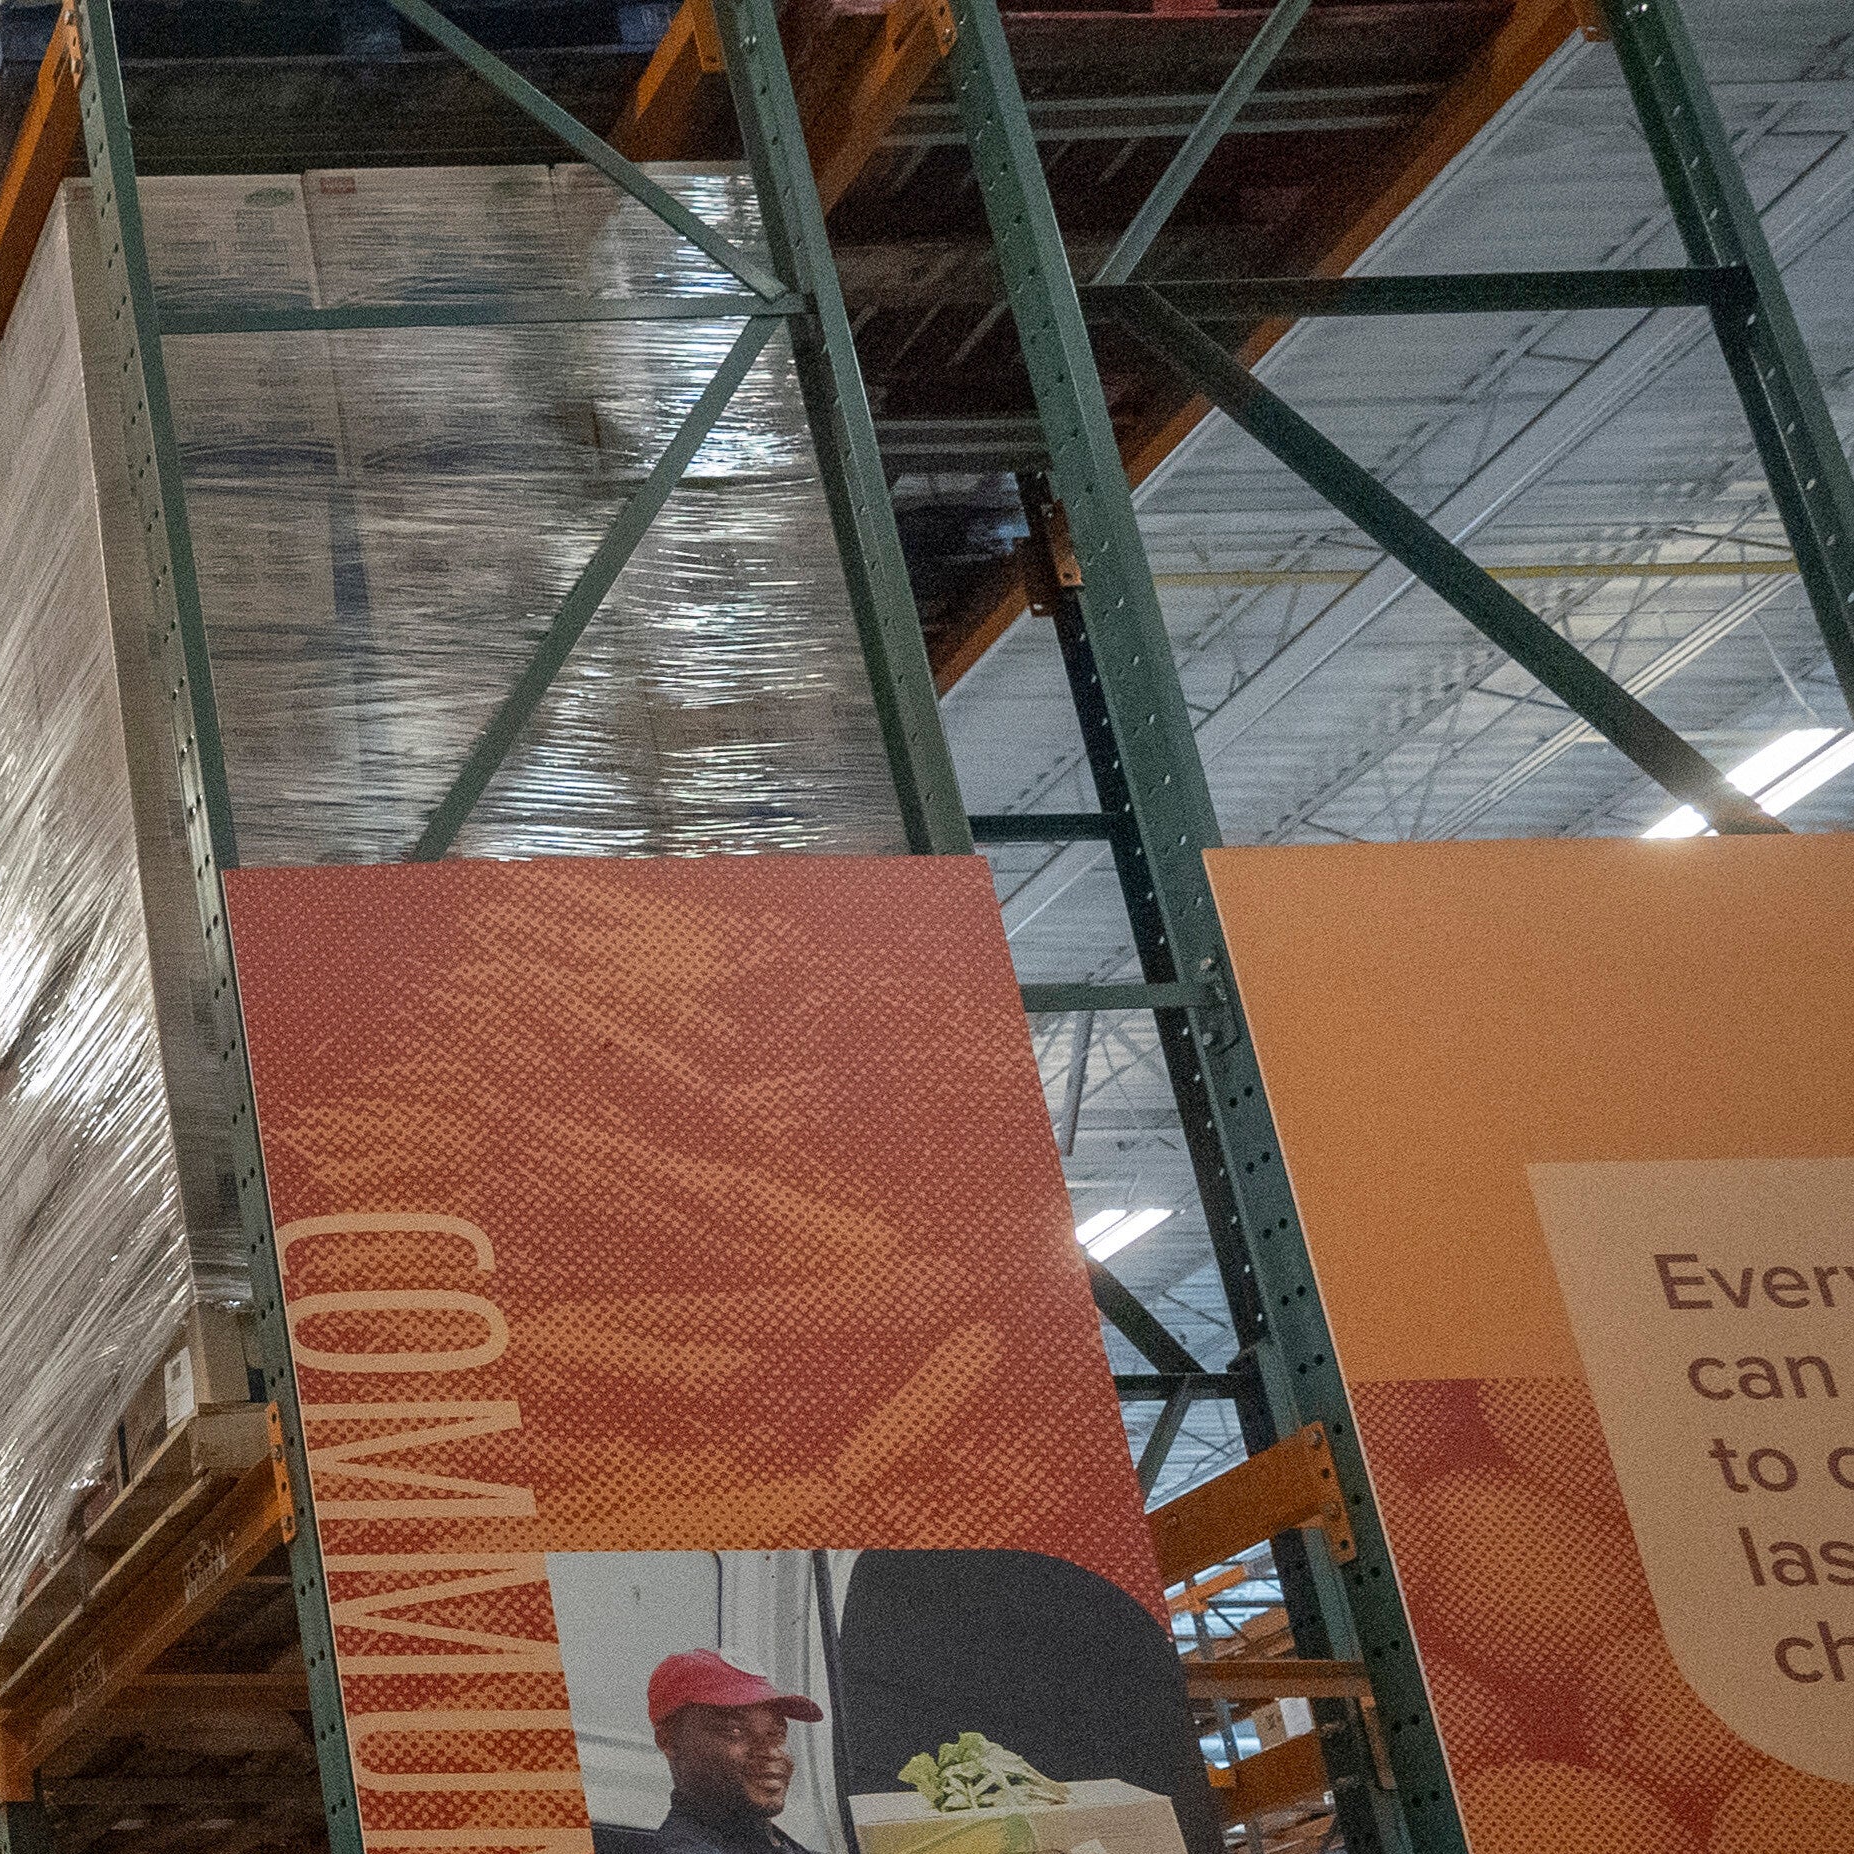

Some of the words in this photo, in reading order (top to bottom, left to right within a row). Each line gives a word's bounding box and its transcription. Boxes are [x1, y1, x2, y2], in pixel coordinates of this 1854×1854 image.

[1654, 1253, 1854, 1311] Ever
[1688, 1354, 1839, 1402] can
[1709, 1438, 1798, 1494] to
